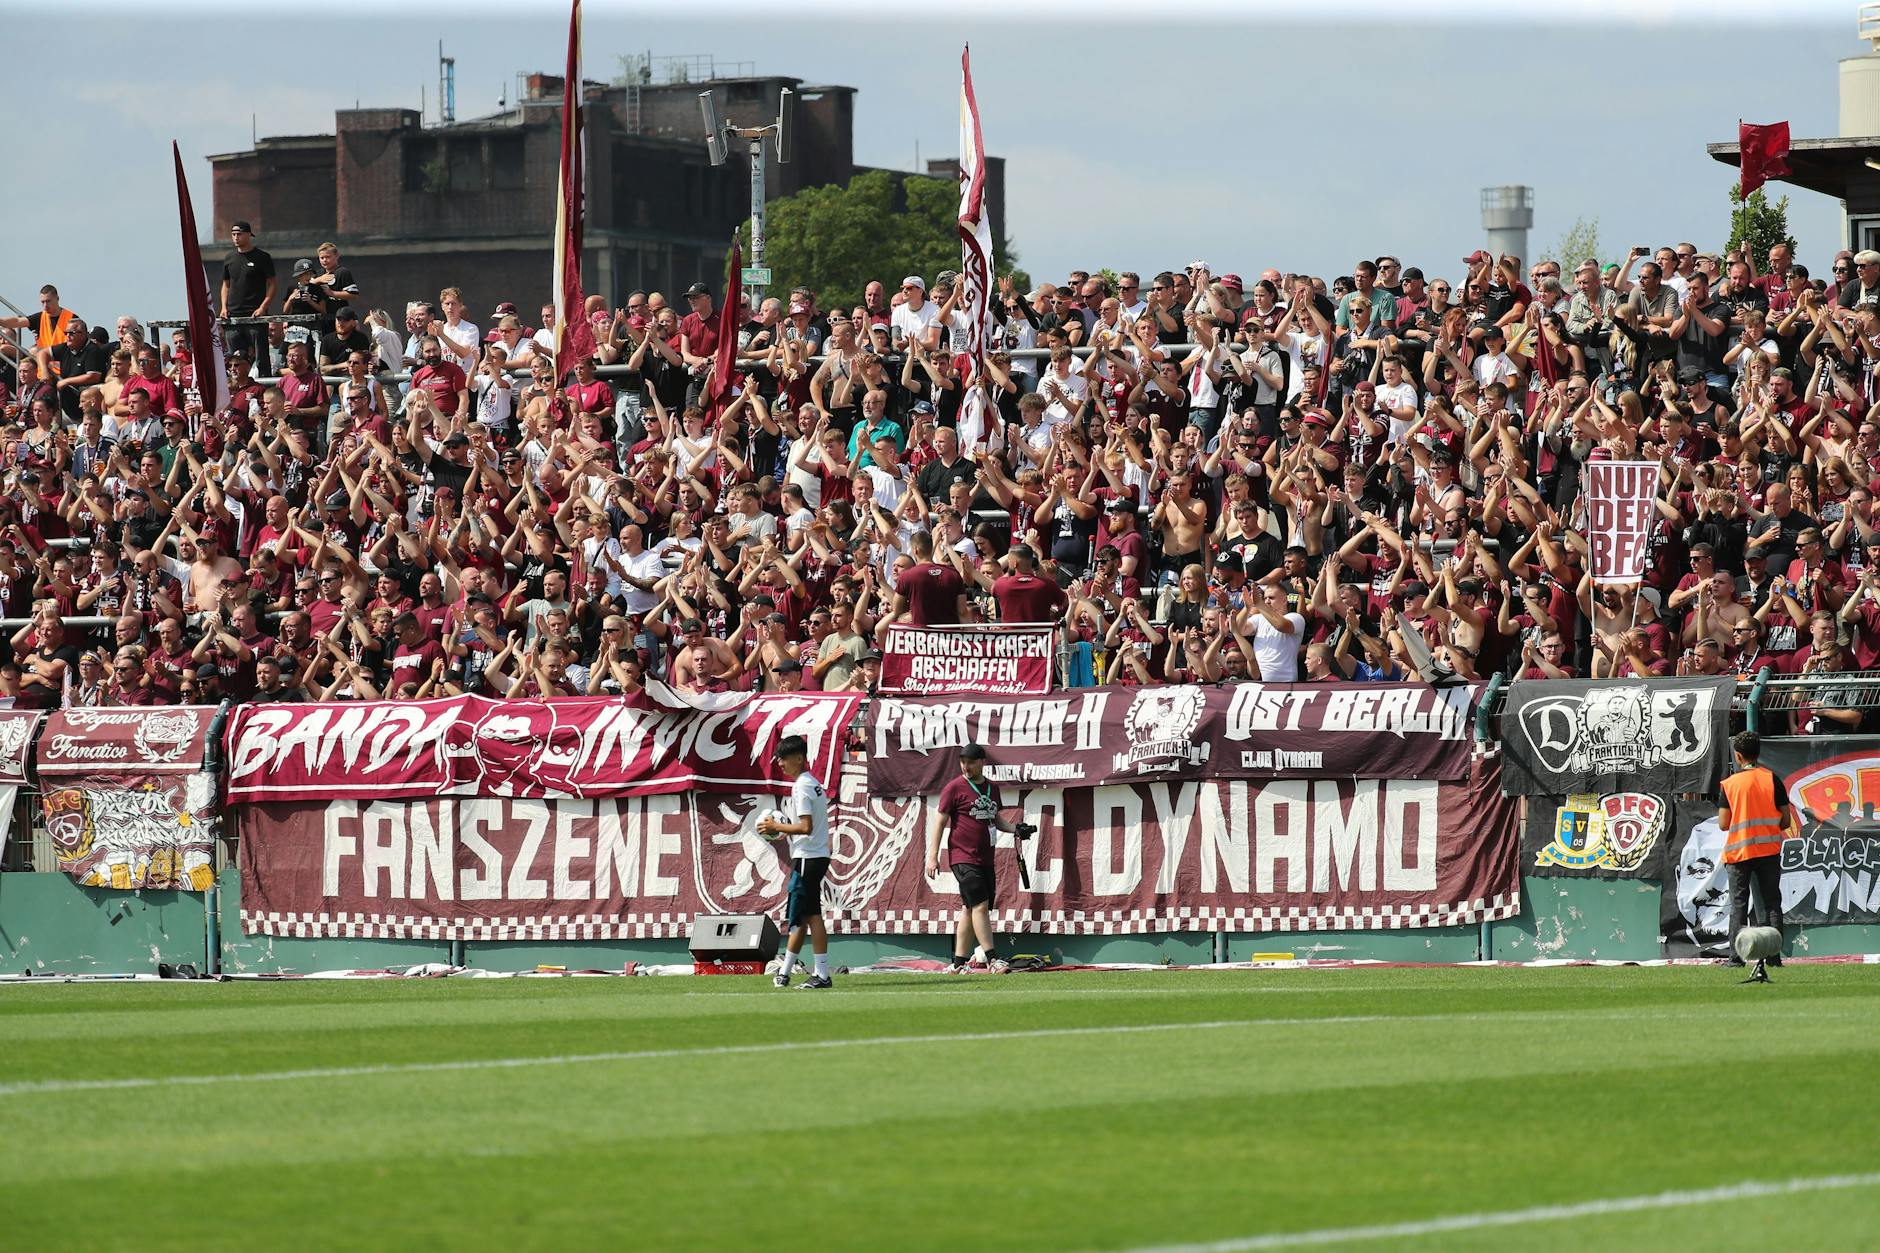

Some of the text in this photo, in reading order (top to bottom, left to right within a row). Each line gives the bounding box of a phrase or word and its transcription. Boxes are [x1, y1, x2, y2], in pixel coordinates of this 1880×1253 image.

[1590, 466, 1657, 499] NUR
[1590, 500, 1652, 533] DER
[1590, 533, 1646, 575] BFC
[885, 630, 1048, 658] VERBANDSSTRAFEN
[911, 656, 1018, 682] ABSCHAFFEN
[901, 676, 1026, 695] Strafen zünden nicht!
[873, 692, 1111, 758] FRAKTION-H
[1224, 684, 1479, 741] OST BERLIN
[46, 734, 129, 759] Fanatico
[231, 700, 837, 780] BANDA INVICTA
[1023, 763, 1085, 782] FUSSBALL
[1241, 749, 1323, 769] CLUB DYNAMO
[1605, 796, 1655, 819] BFC
[323, 797, 681, 901] FANSZENE
[1093, 779, 1439, 896] DYNAMO
